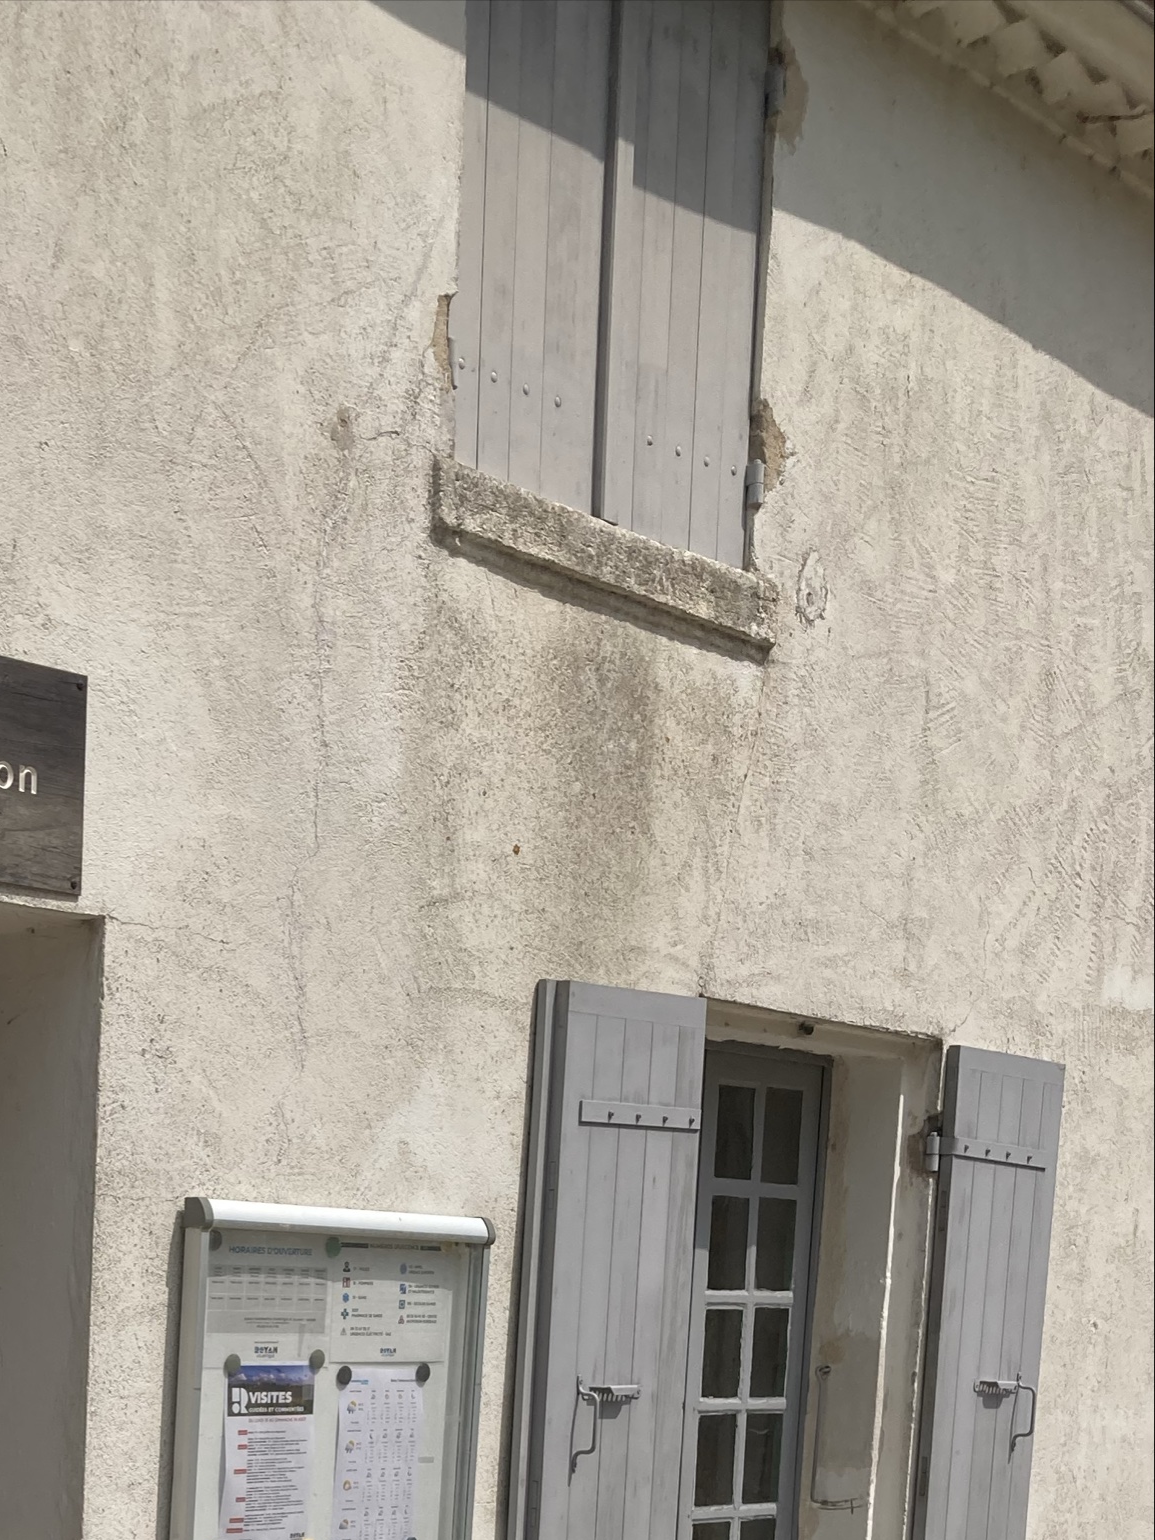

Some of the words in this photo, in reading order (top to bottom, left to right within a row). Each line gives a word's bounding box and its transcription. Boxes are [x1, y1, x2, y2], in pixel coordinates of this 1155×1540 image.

[229, 1246, 266, 1255] HORAIRES
[267, 1247, 313, 1256] D'OUVERTURE
[249, 1391, 292, 1404] VISITES
